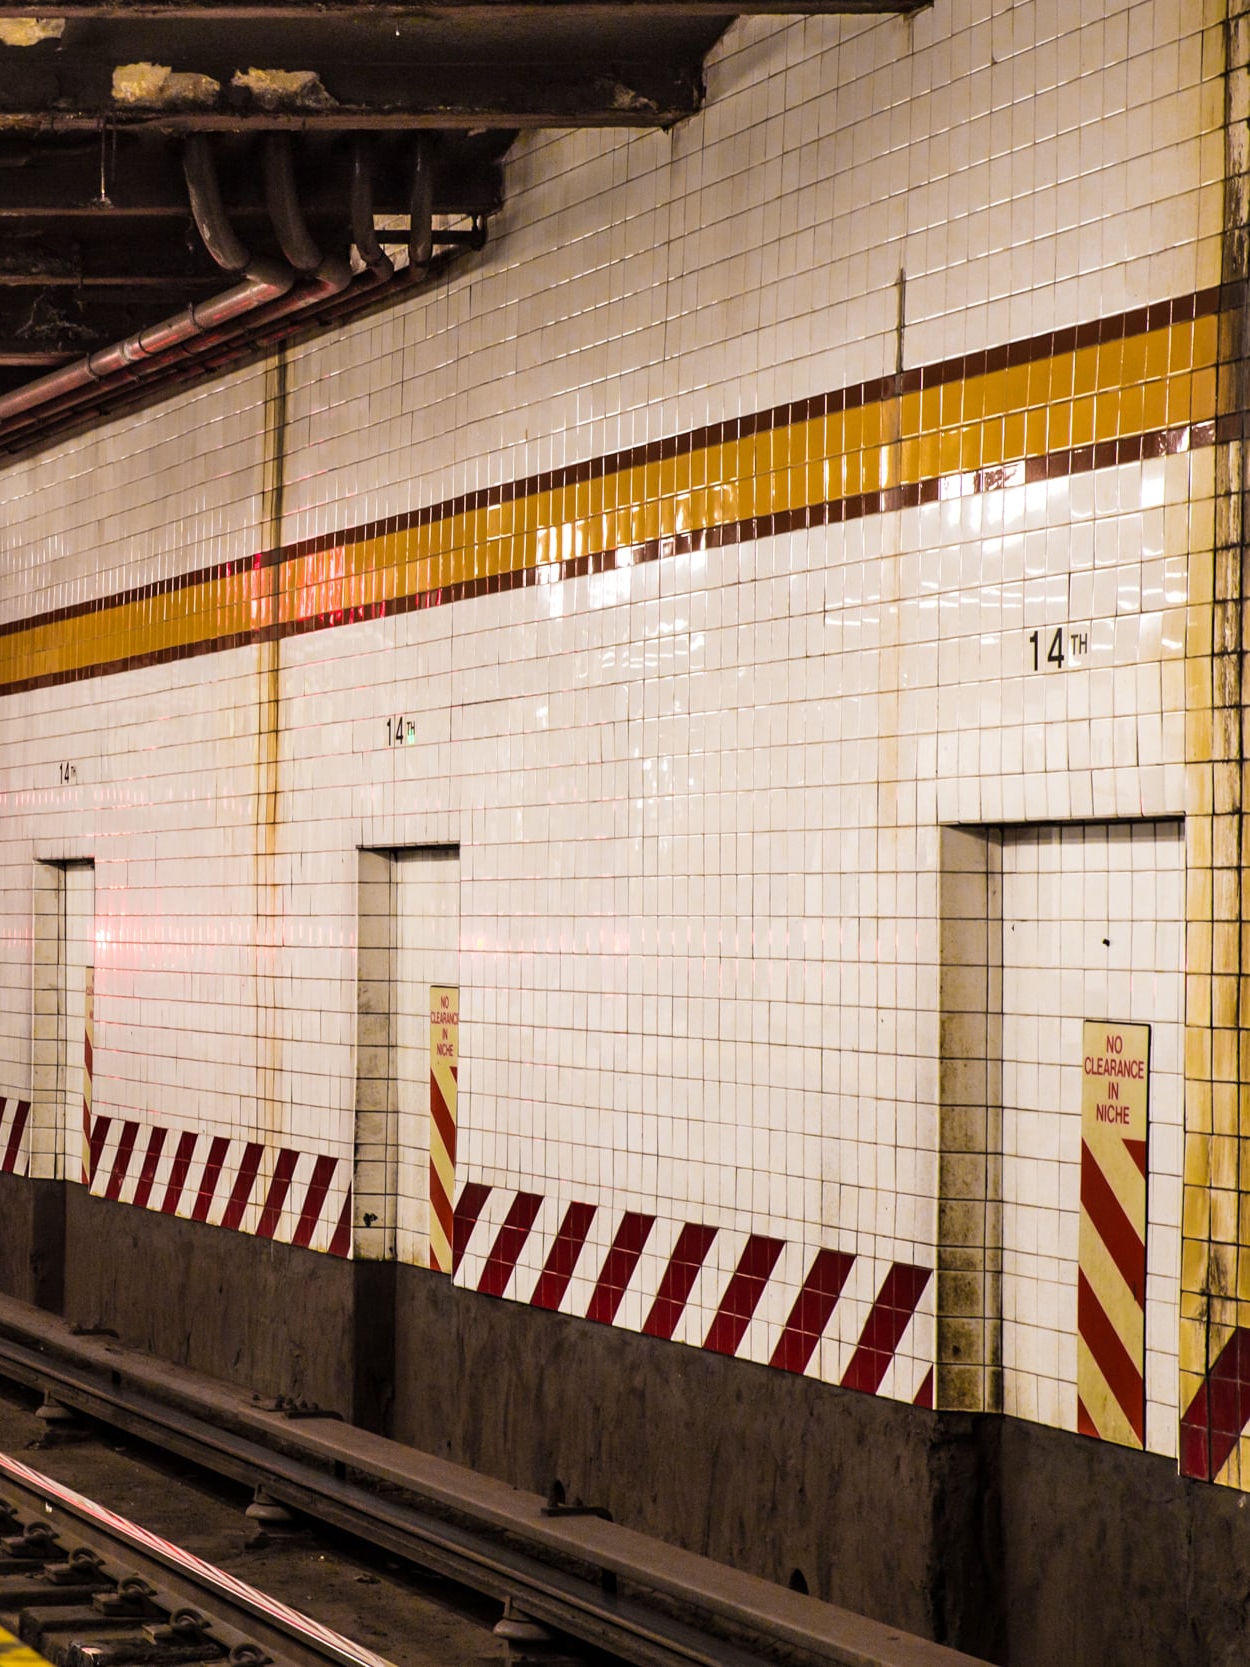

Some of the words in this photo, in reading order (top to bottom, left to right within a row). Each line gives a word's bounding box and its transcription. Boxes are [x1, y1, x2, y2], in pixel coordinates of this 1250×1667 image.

[1029, 627, 1088, 671] 14TH
[440, 995, 450, 1009] NO
[442, 1027, 449, 1041] IN
[436, 1043, 454, 1057] NICHE
[1106, 1034, 1123, 1055] NO
[1084, 1056, 1145, 1080] CLEARANCE
[1108, 1081, 1119, 1101] IN
[1096, 1103, 1130, 1125] NICHE
